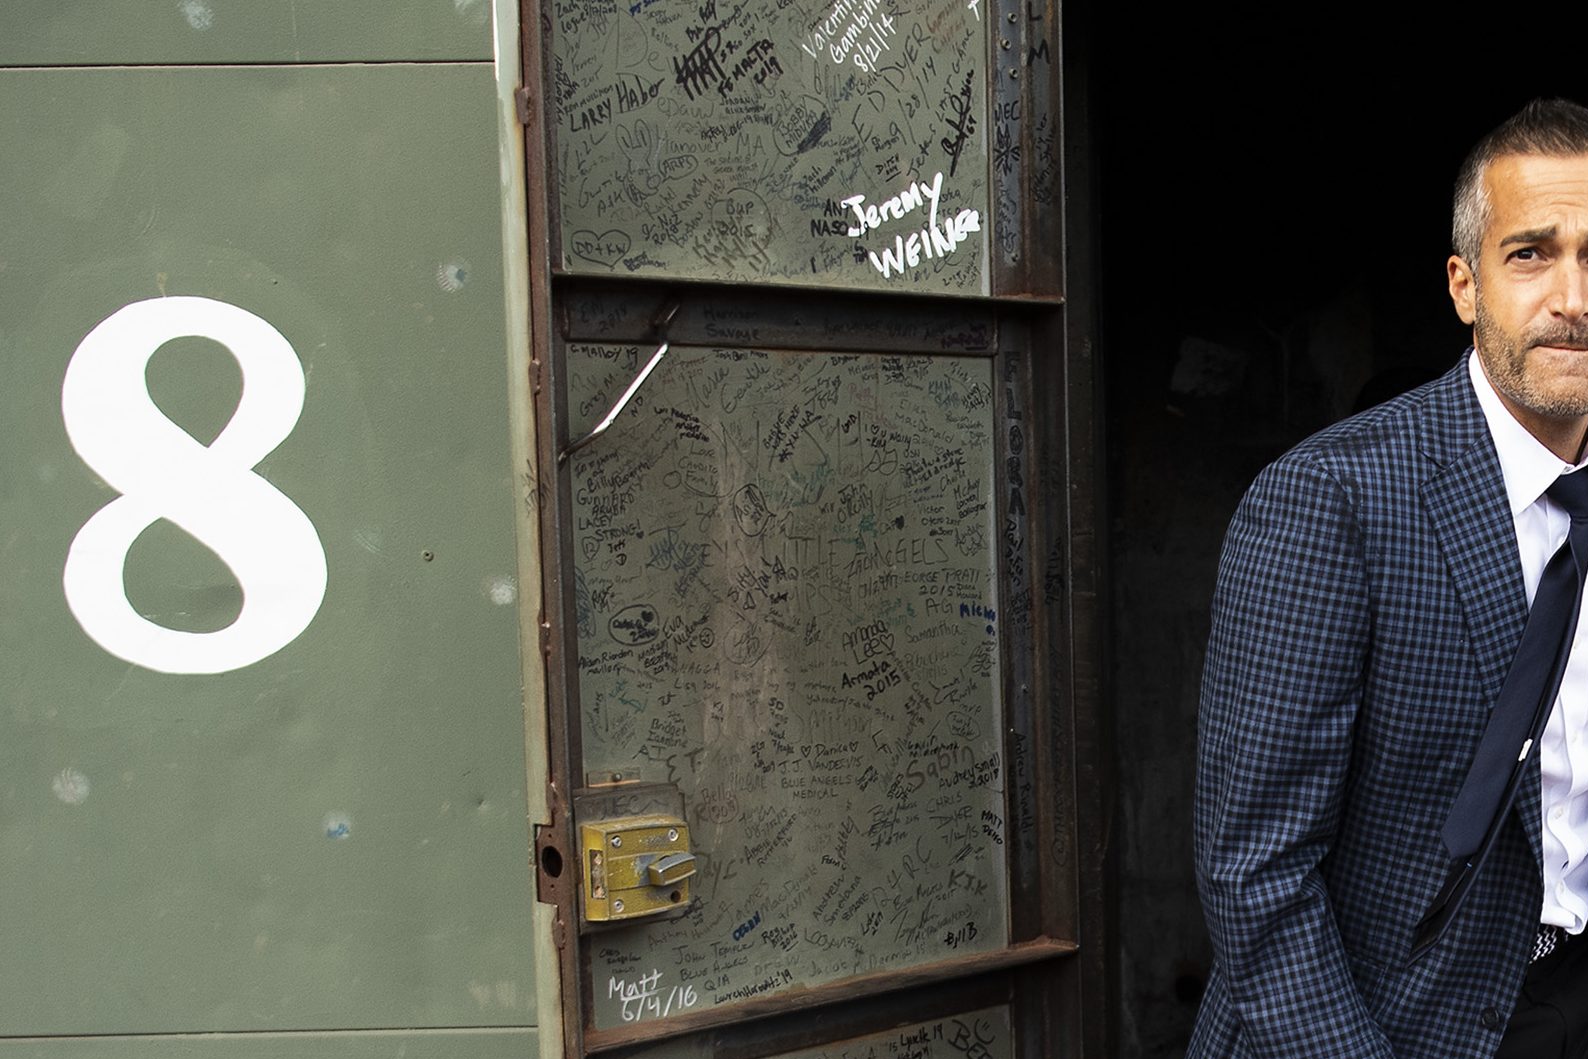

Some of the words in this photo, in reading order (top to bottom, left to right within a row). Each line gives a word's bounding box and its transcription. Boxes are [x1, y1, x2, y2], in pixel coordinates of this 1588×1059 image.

[853, 12, 897, 73] 8/21/14
[879, 22, 932, 95] DYER
[569, 98, 613, 133] LARRY
[840, 170, 944, 238] Jeremy
[705, 323, 761, 341] Savage
[62, 295, 329, 675] 8
[579, 514, 614, 531] LACEY
[918, 582, 956, 598] 2015
[840, 619, 890, 652] Amanda
[862, 672, 902, 700] 2015
[792, 788, 840, 800] MEDICAL
[608, 967, 665, 1001] Matt
[621, 985, 699, 1023] 6/4/16
